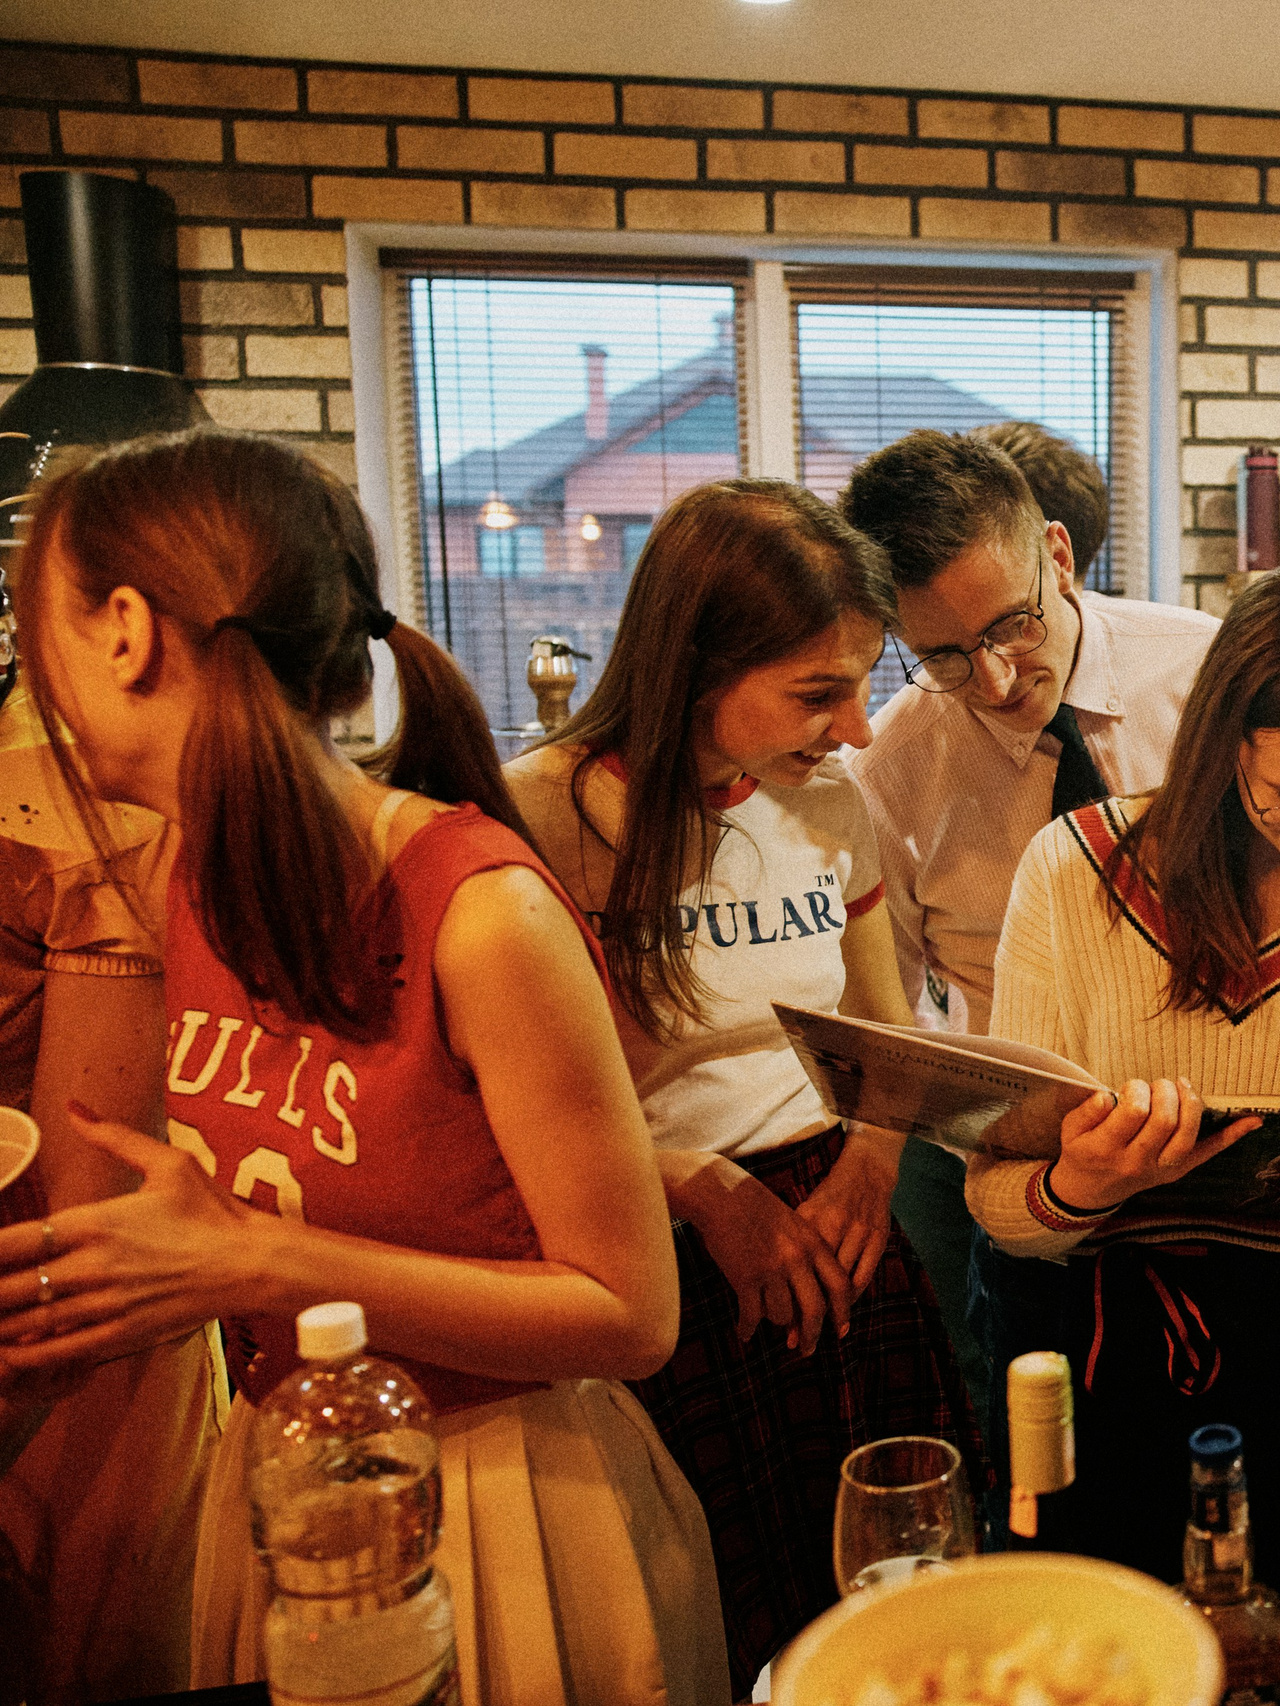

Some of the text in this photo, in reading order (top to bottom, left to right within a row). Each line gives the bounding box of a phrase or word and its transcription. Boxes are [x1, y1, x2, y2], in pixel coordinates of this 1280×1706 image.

[814, 873, 835, 888] TM
[630, 890, 844, 951] PULAR
[166, 1009, 358, 1166] ULLS
